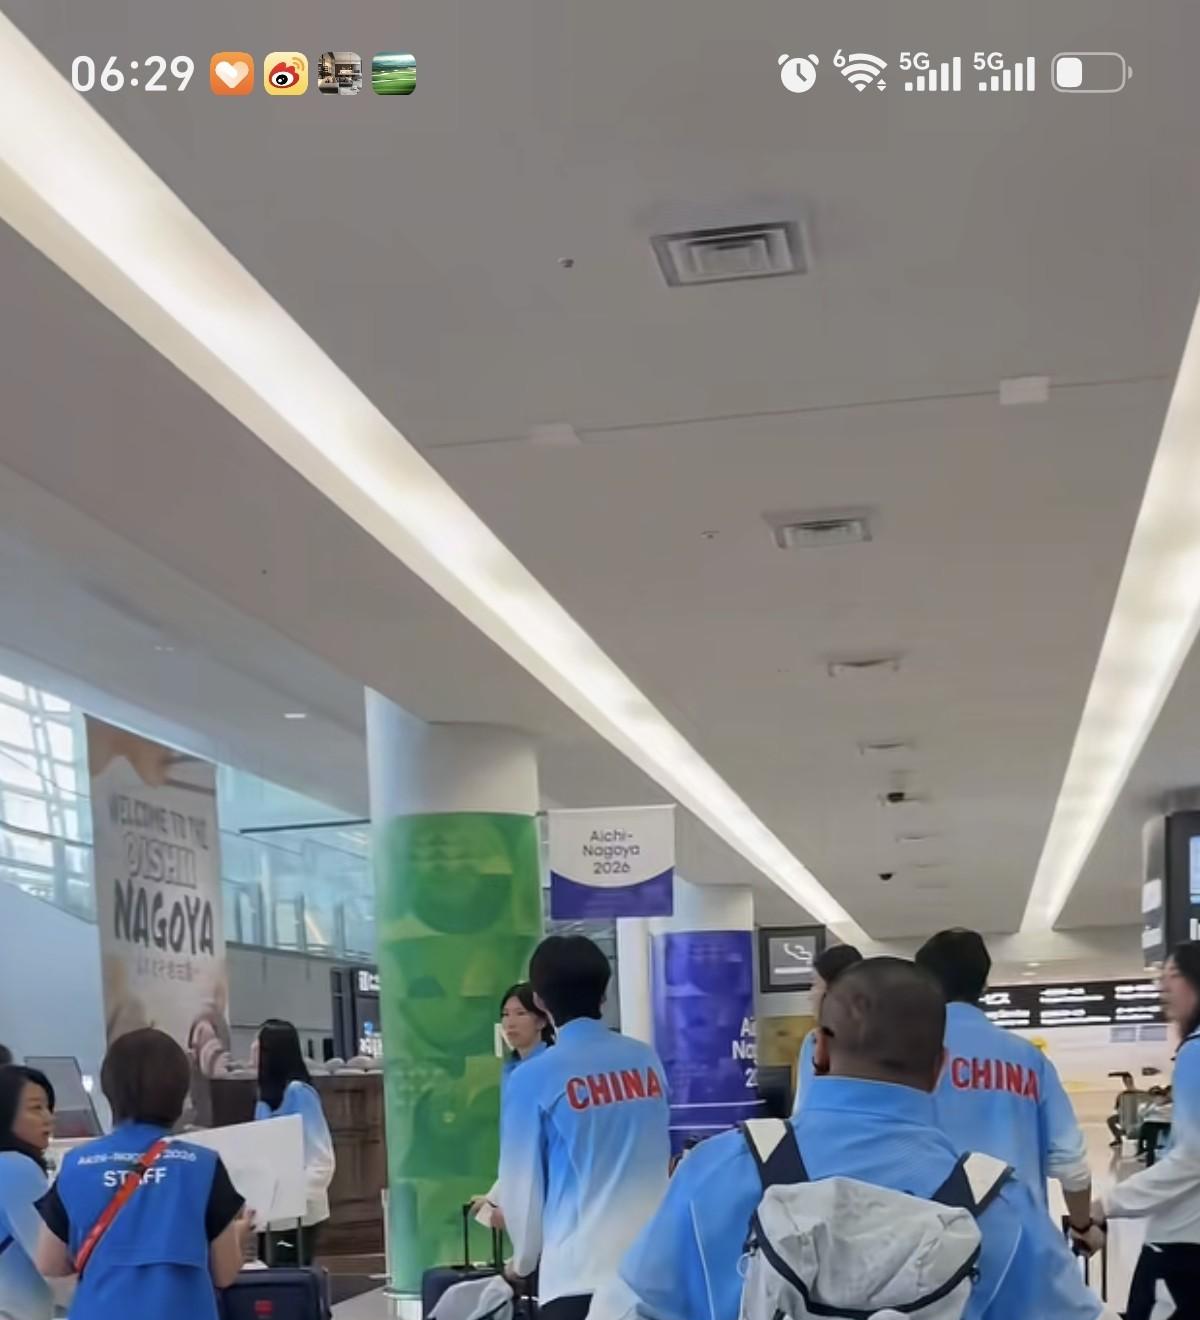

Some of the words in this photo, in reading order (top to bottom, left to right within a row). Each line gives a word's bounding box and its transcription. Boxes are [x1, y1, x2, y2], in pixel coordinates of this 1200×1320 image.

[110, 793, 168, 834] WELCOME
[589, 828, 634, 842] Aichi-
[582, 844, 641, 860] Nagoya
[593, 860, 632, 875] 2026
[114, 877, 215, 957] NAGOYA
[566, 1066, 663, 1110] CHINA
[951, 1056, 1041, 1105] CHINA
[103, 1166, 168, 1188] STFF
